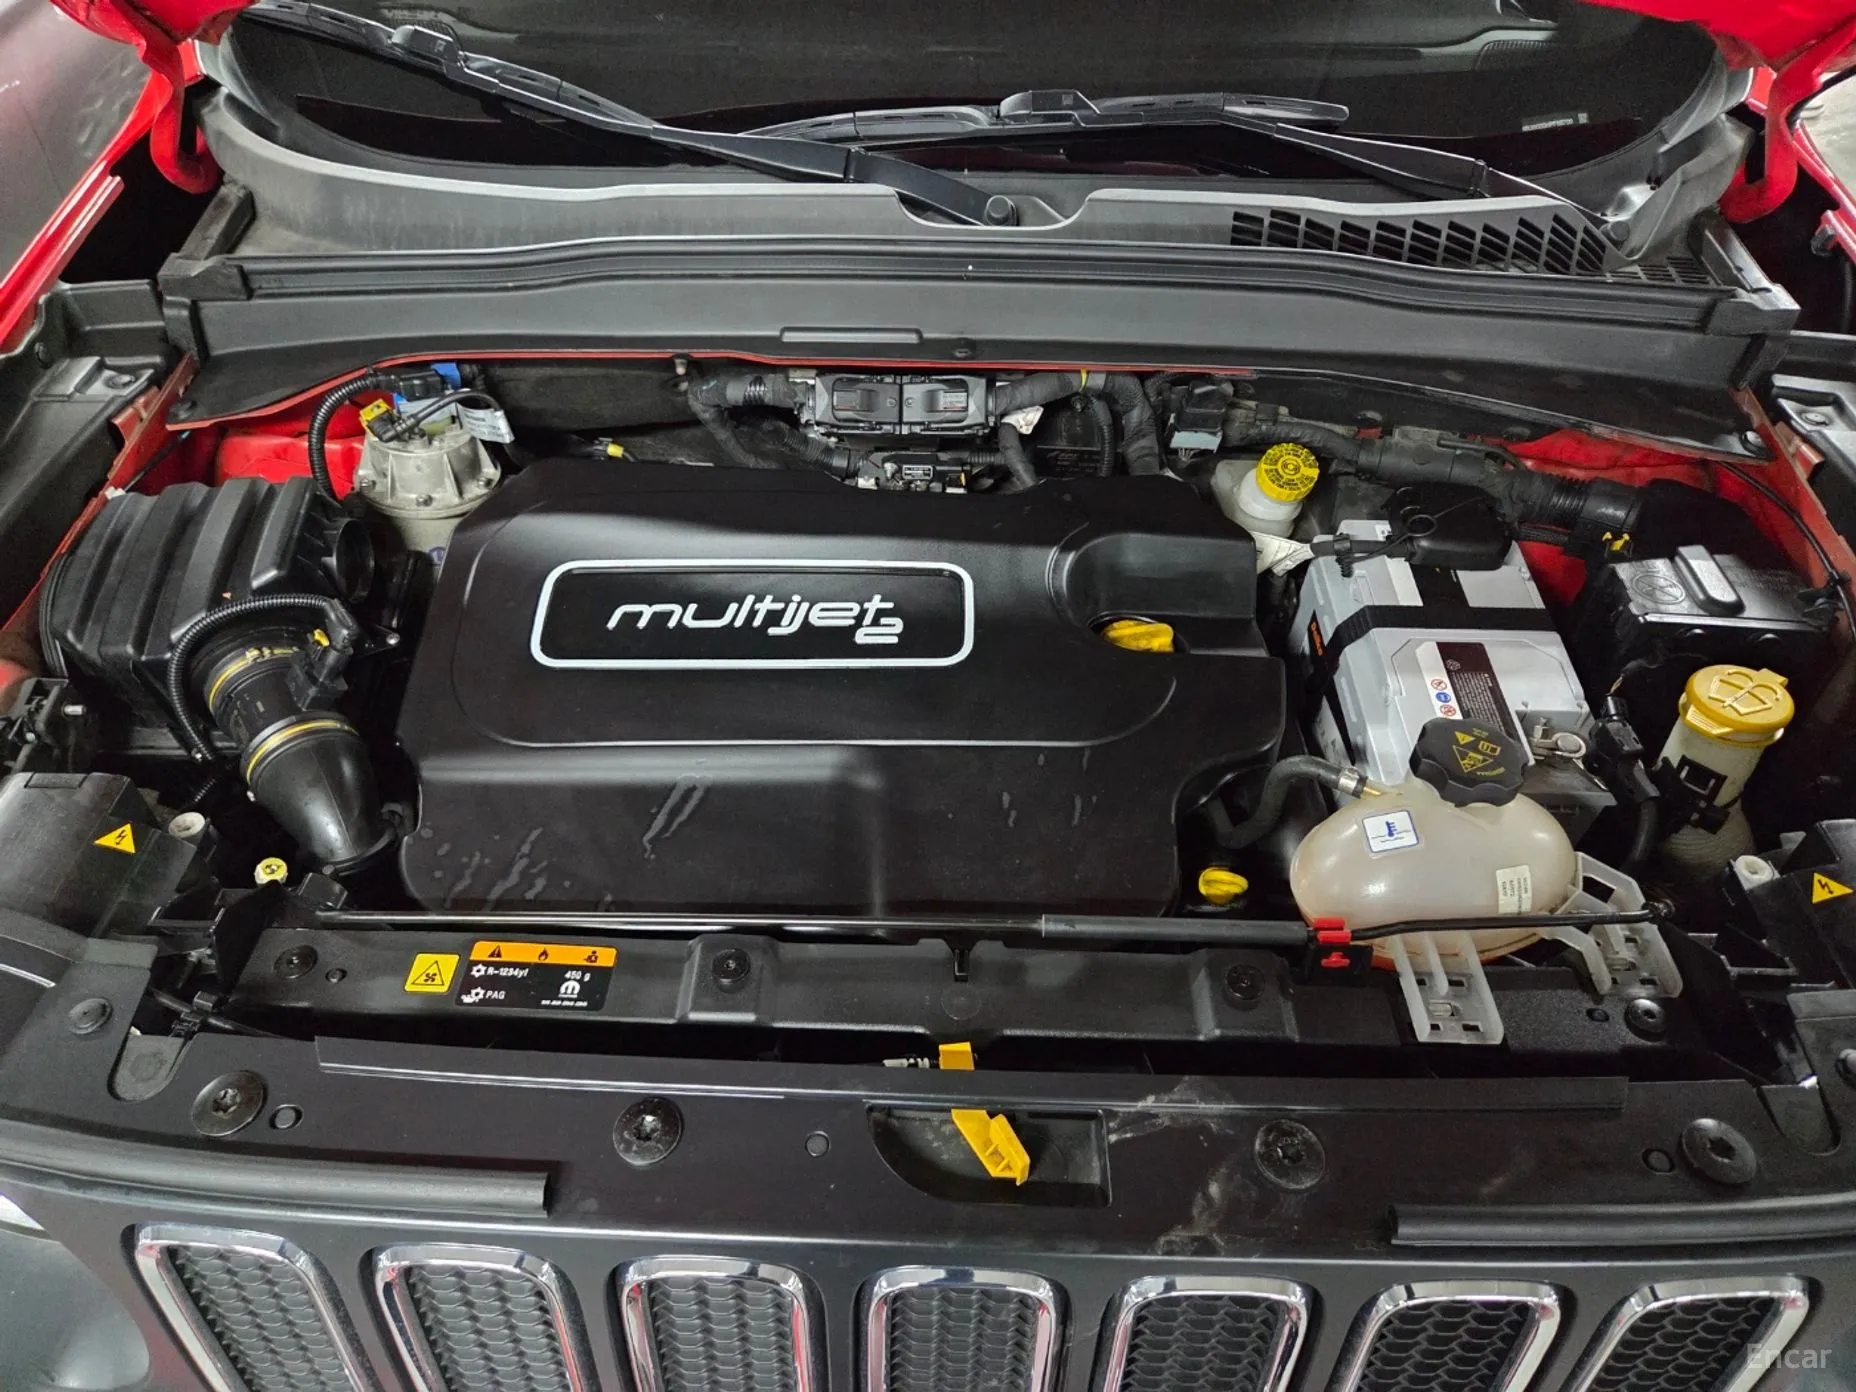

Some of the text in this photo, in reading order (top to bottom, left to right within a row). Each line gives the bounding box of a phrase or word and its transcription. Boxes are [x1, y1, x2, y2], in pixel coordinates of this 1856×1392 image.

[487, 966, 529, 978] R-1234yf
[564, 970, 582, 980] 450
[485, 990, 506, 1000] PAG
